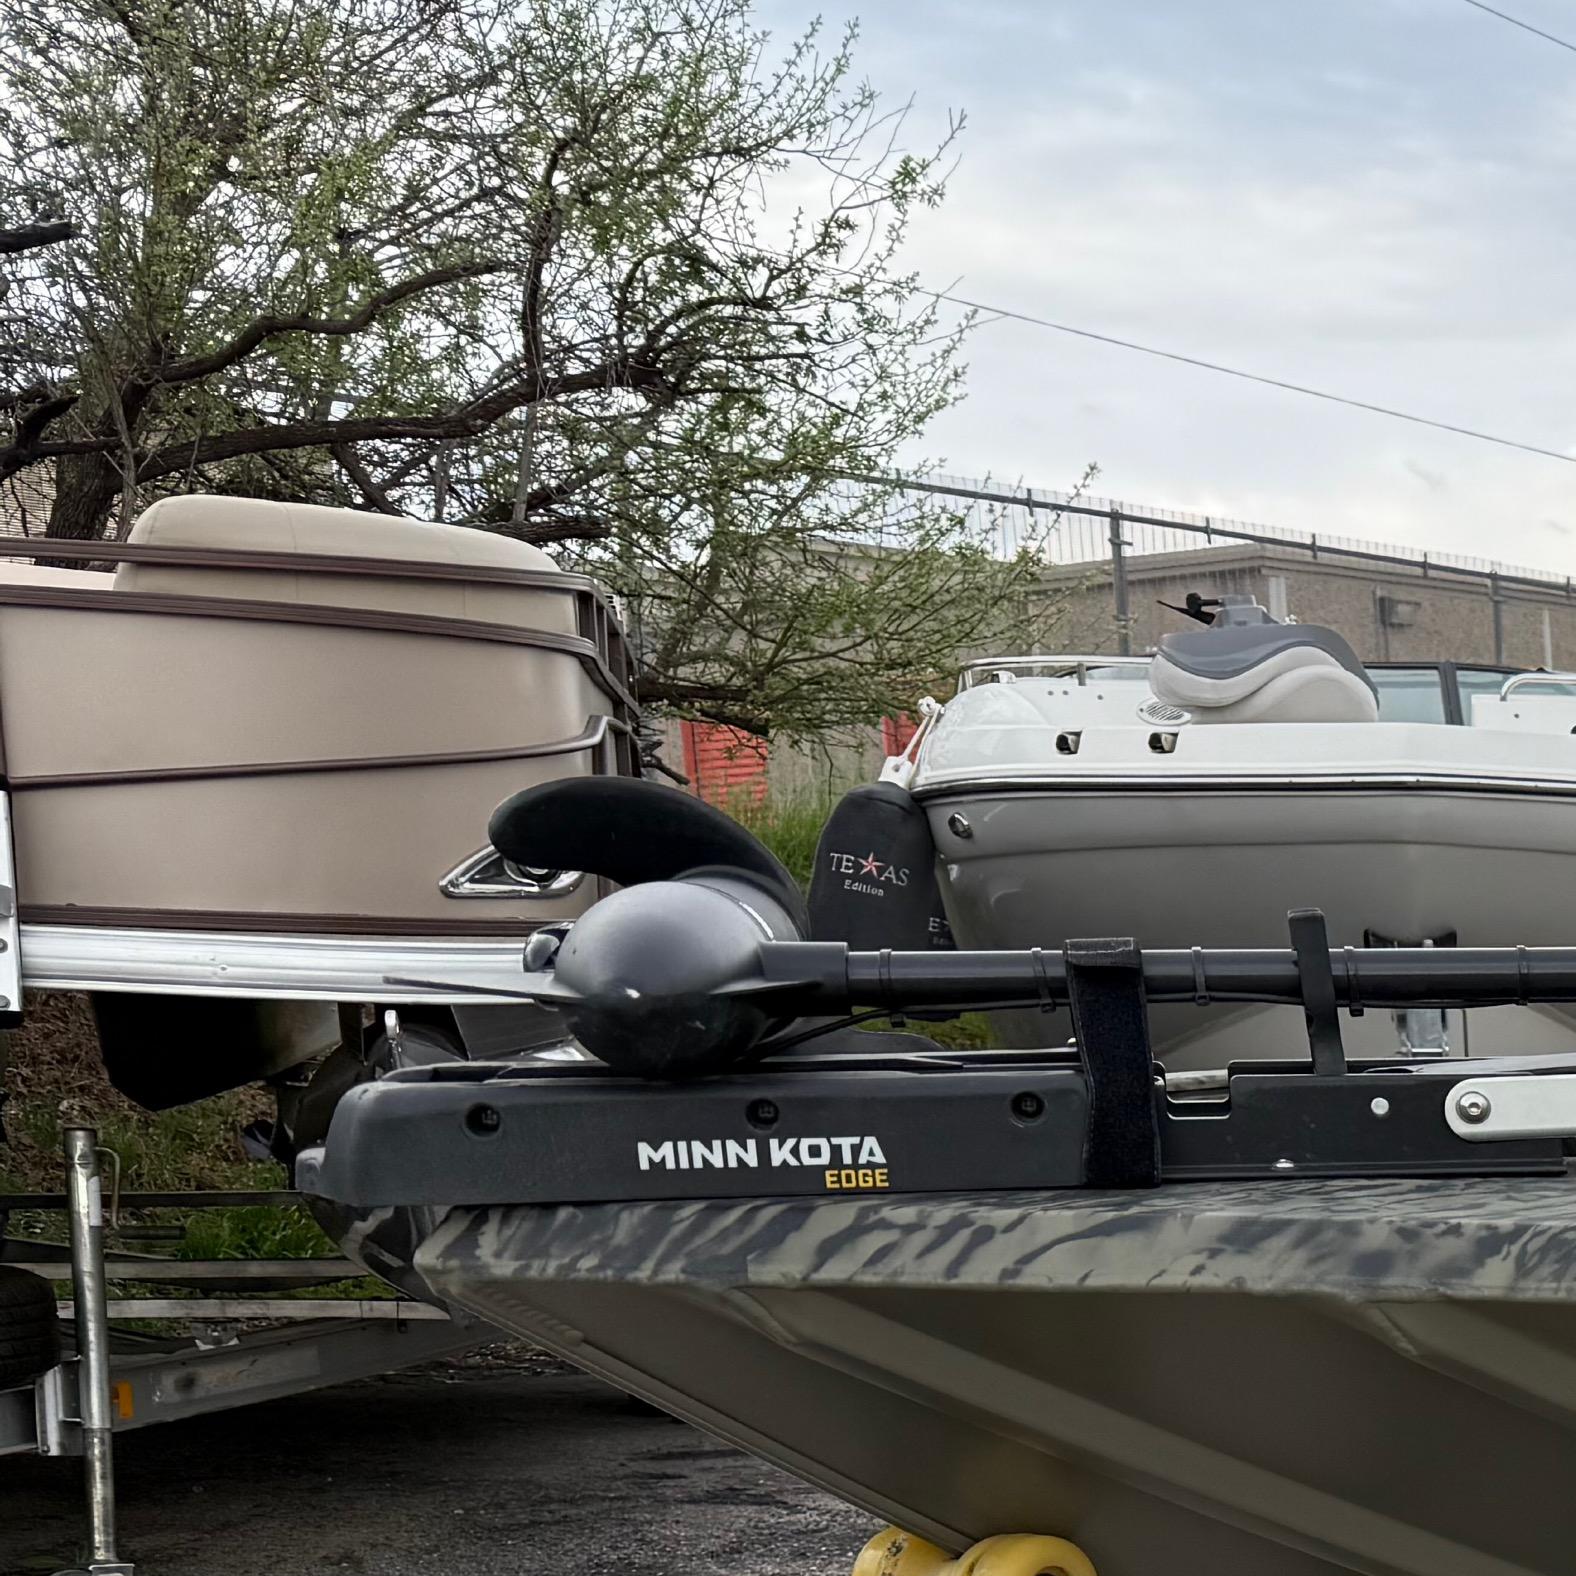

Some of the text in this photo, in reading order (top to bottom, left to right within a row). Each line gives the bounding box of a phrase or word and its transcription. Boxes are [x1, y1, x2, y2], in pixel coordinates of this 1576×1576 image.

[844, 879, 884, 897] Edition
[637, 1136, 887, 1170] MINN KOTA
[825, 1168, 889, 1188] EDGE
